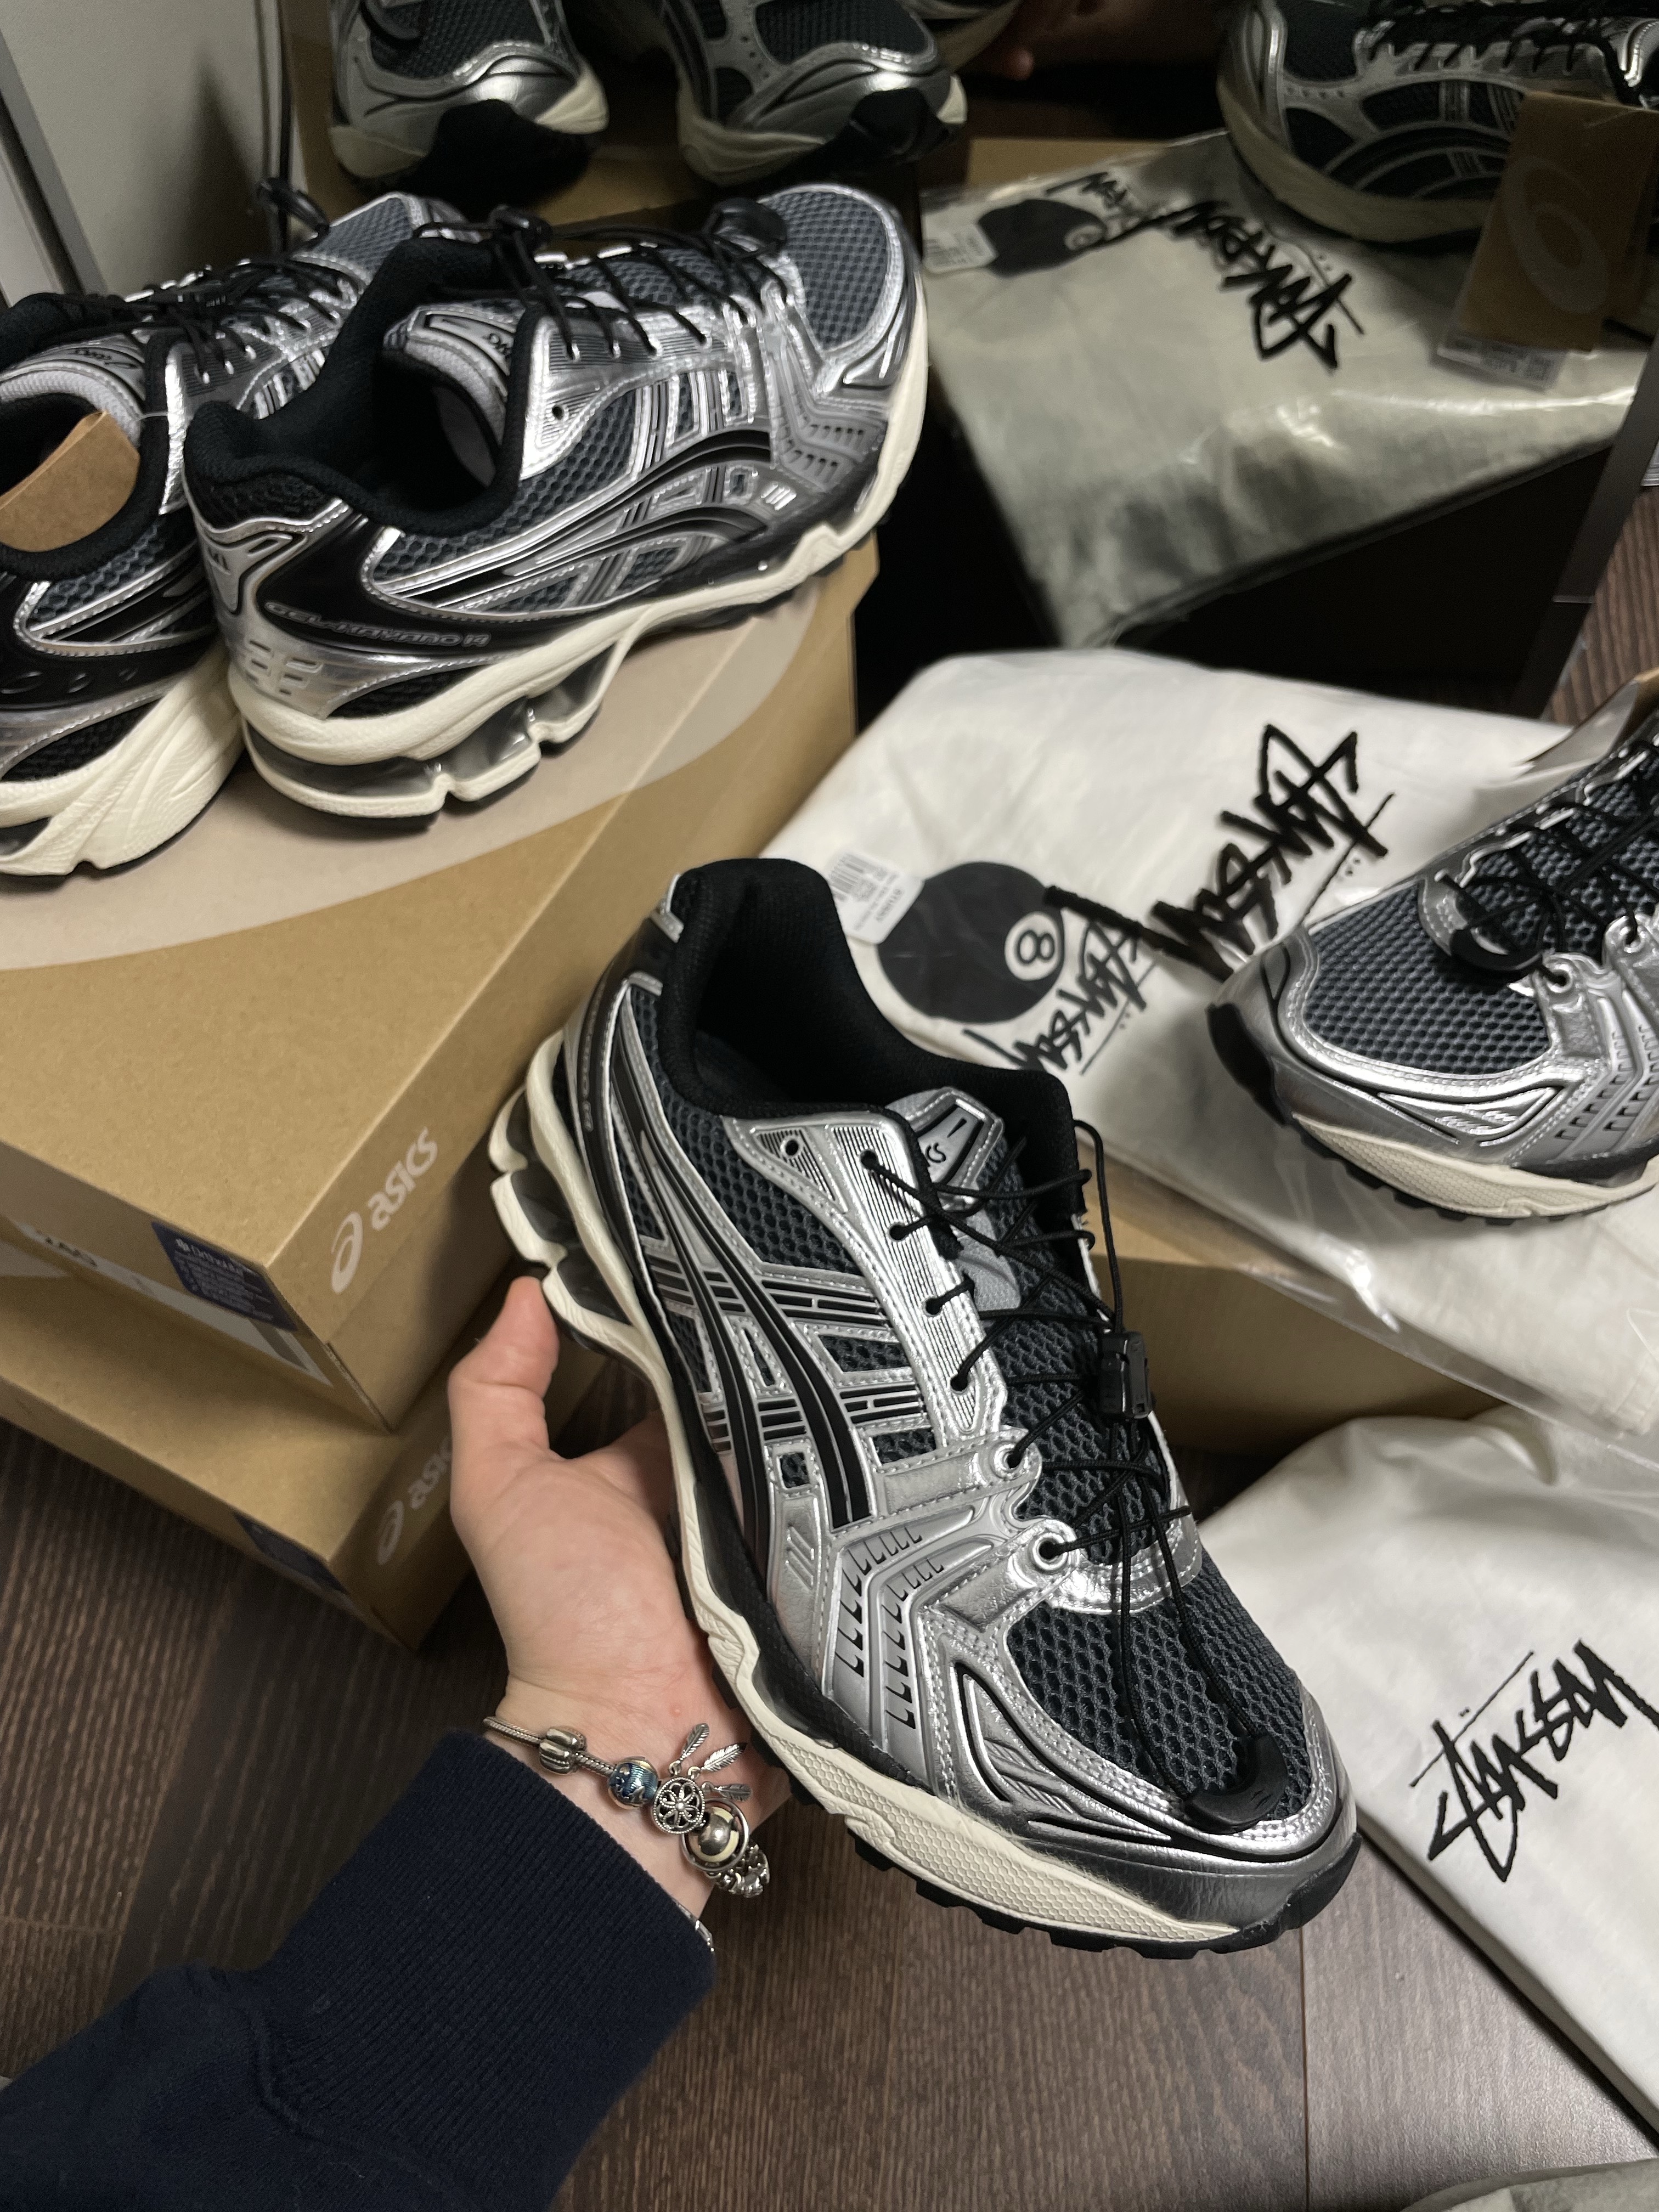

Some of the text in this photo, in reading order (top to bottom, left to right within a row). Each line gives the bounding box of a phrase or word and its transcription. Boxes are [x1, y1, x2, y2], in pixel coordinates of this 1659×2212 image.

[1016, 929, 1055, 964] 8
[367, 1126, 438, 1231] asics
[407, 1436, 452, 1510] asic
